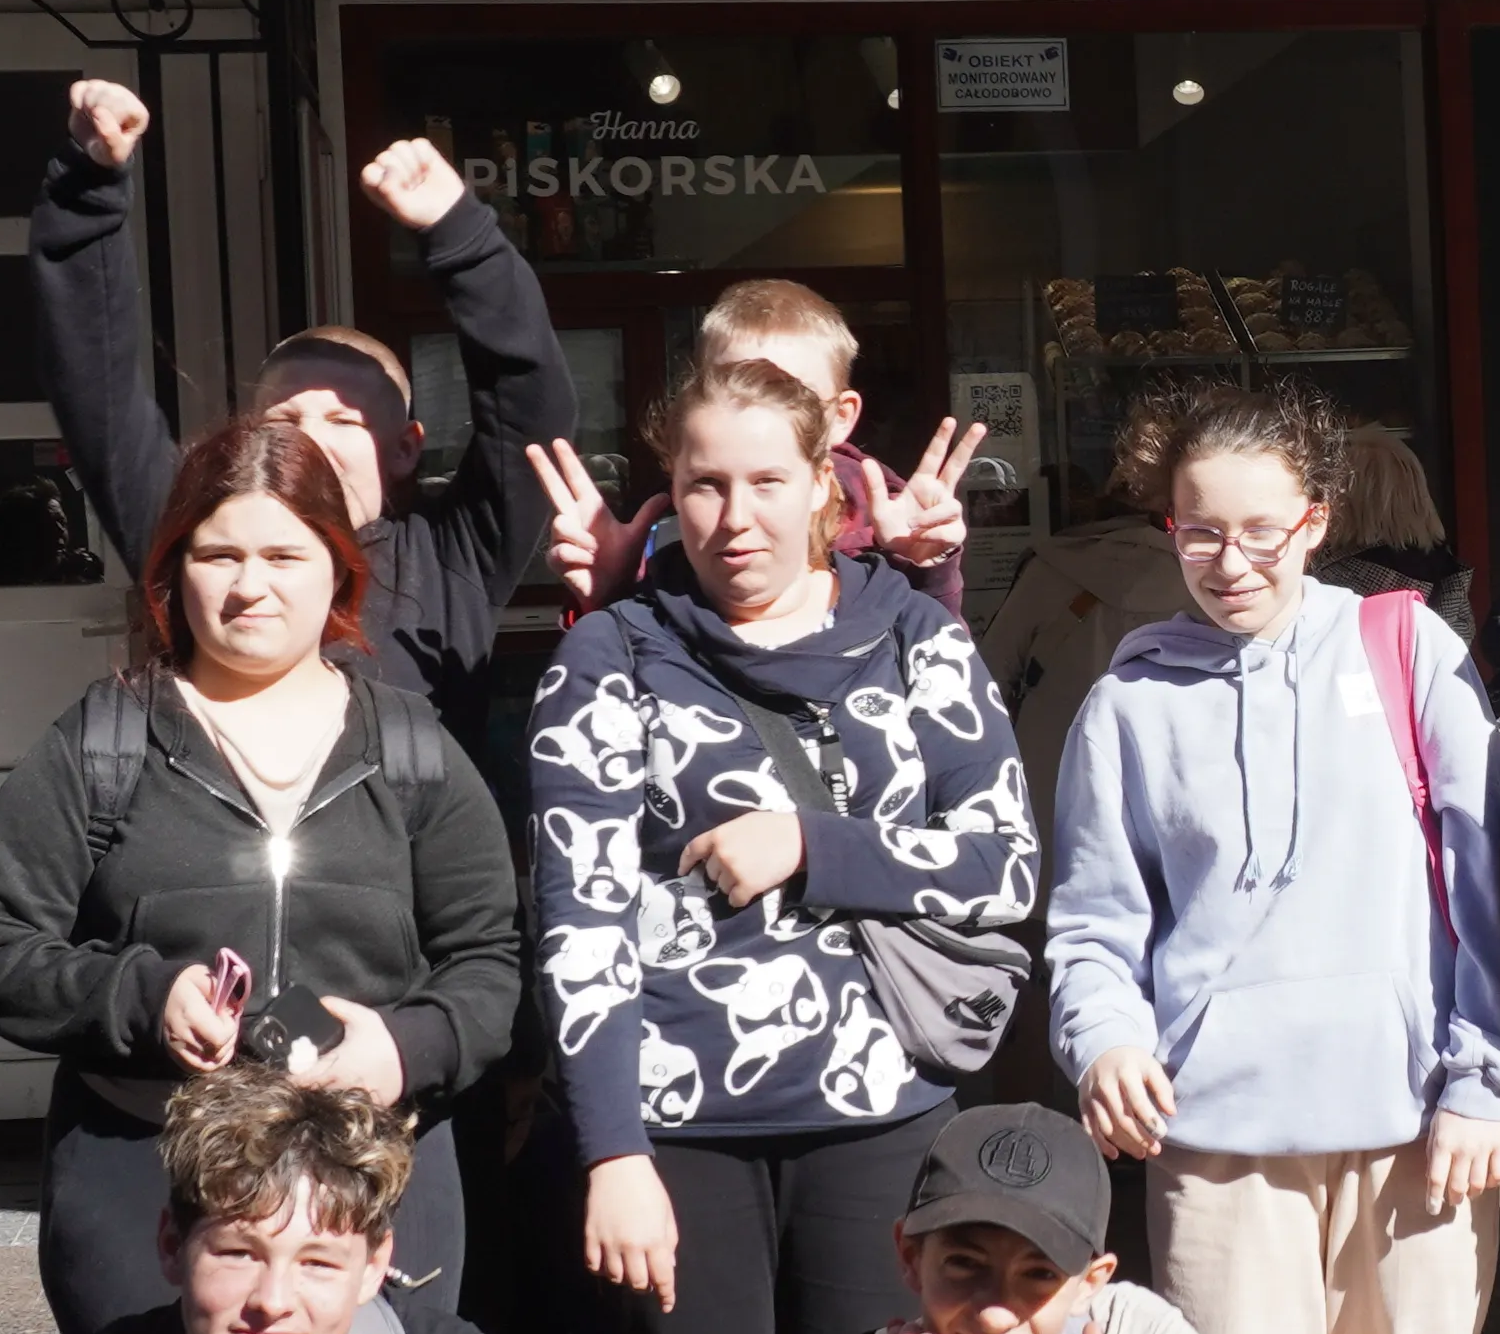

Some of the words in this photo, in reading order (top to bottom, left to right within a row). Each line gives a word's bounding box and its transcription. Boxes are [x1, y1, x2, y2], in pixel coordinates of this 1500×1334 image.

[968, 54, 1035, 68] OBIEKT
[947, 71, 1057, 85] MONITOROWANY
[954, 86, 1052, 101] CAŁODOBOWO
[590, 109, 701, 140] Hanna
